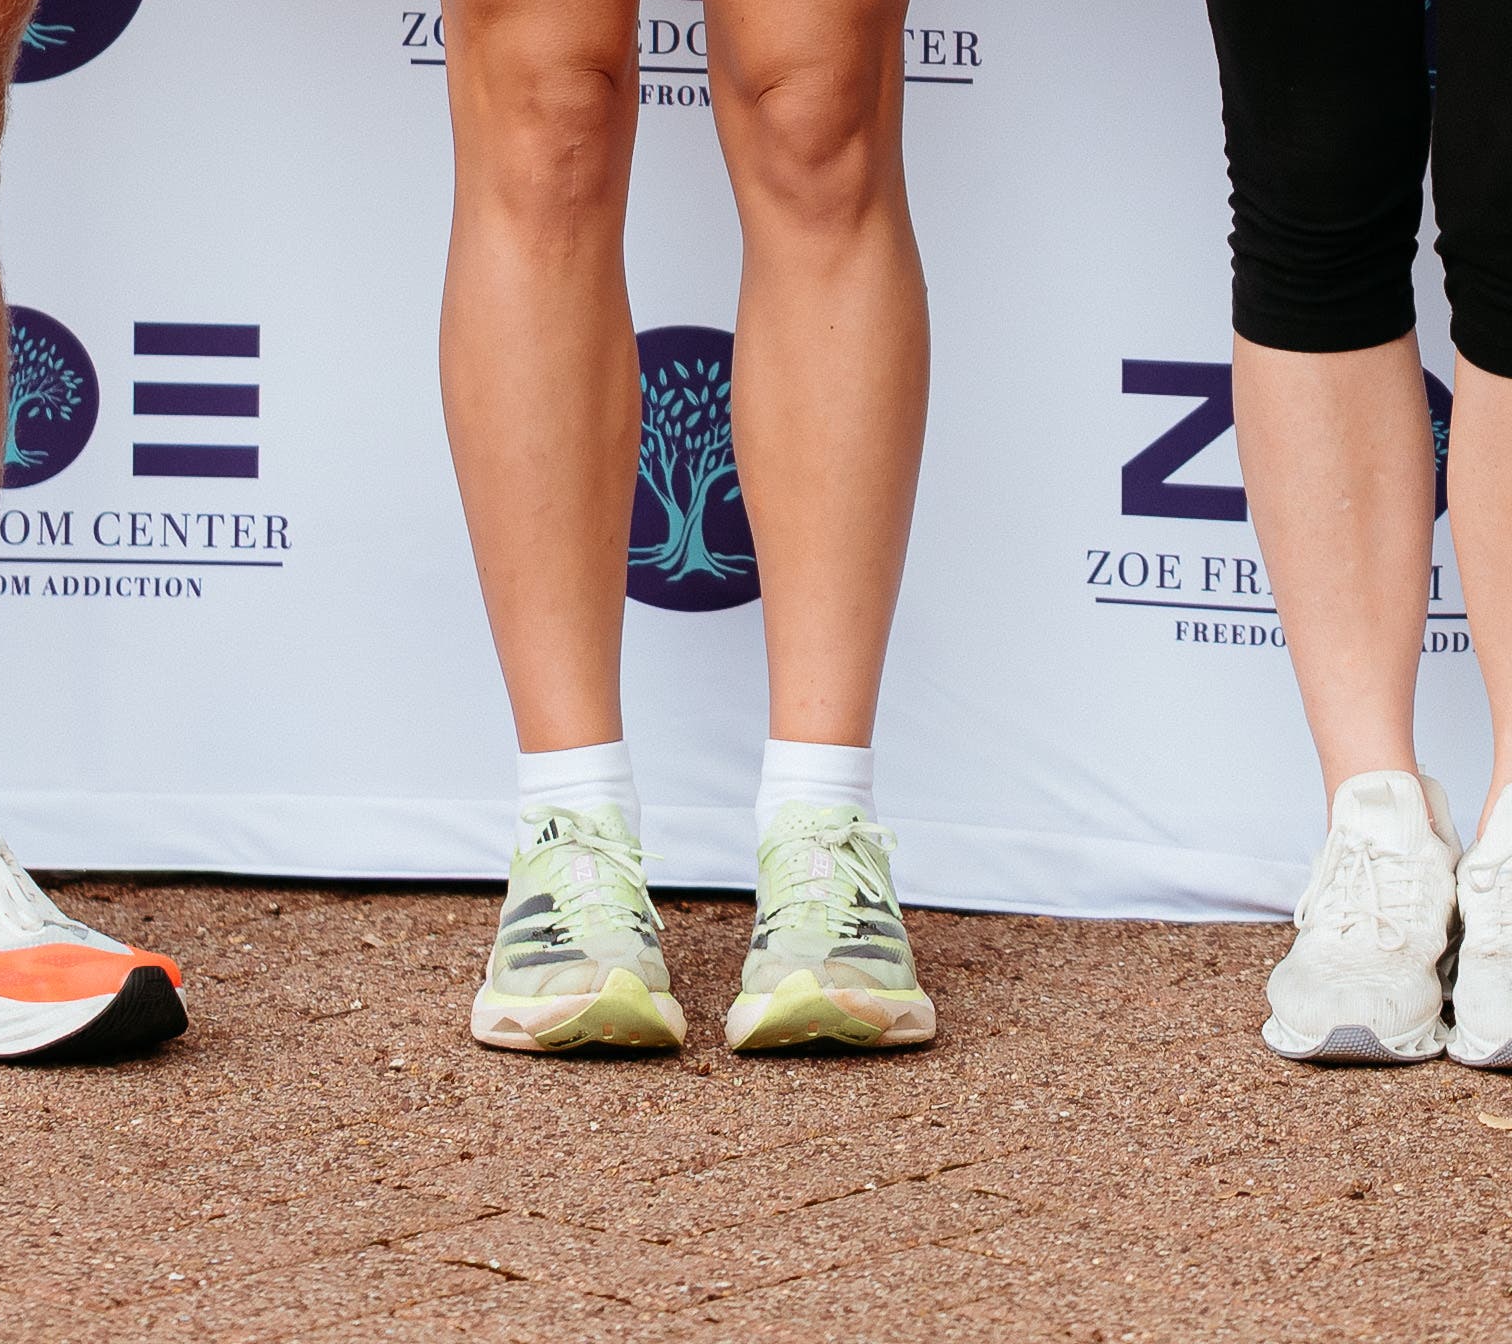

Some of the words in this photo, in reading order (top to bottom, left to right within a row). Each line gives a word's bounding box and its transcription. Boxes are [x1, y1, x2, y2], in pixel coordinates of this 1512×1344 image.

[92, 510, 290, 551] CENTER
[41, 573, 204, 599] ADDICTION
[1085, 548, 1183, 591] ZOE
[1175, 619, 1286, 649] FREEDO
